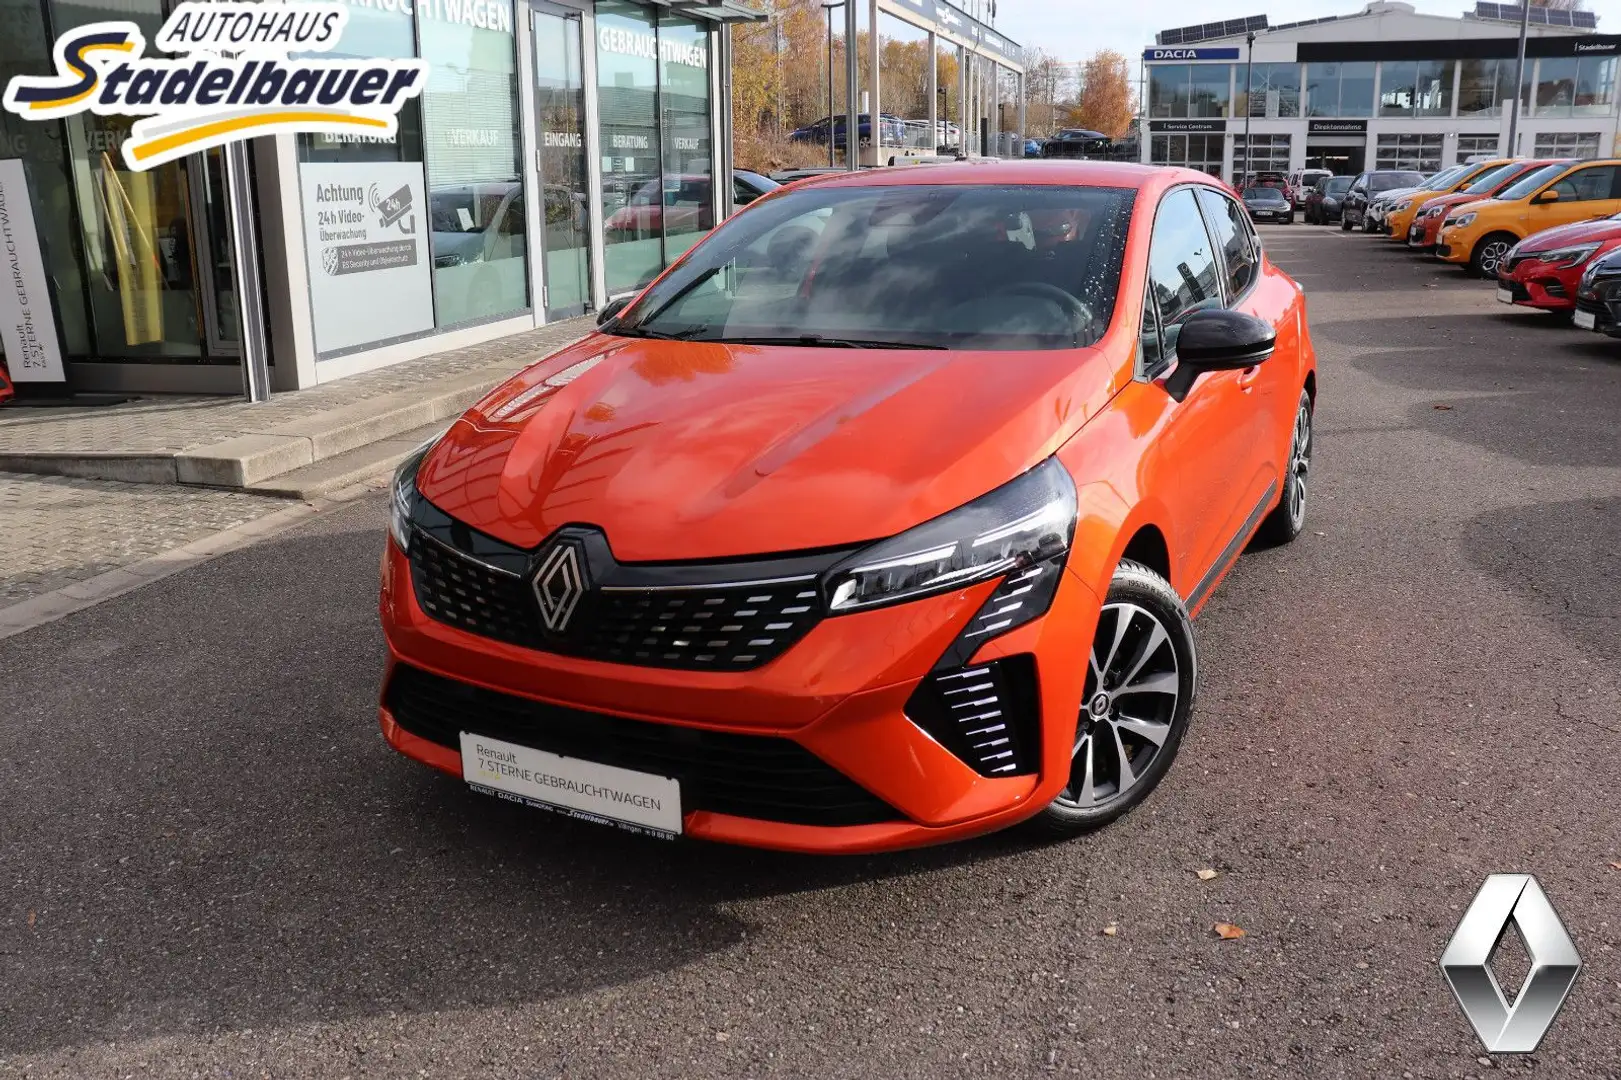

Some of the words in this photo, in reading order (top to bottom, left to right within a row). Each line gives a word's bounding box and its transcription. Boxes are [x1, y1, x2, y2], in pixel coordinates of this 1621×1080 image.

[600, 26, 707, 68] GEBRAUCHTWAGEN
[1154, 49, 1197, 59] DACIA
[450, 128, 499, 146] VERKAUF
[544, 132, 582, 148] EINGANG
[613, 134, 649, 149] BERATUNG
[674, 137, 700, 150] VERKAUF
[316, 183, 364, 205] Achtung
[338, 208, 365, 225] Video-
[0, 182, 29, 306] GEBRAUCHTWAG
[320, 228, 367, 241] Überwachung
[23, 309, 40, 358] STERNE
[16, 324, 31, 368] Renault
[476, 743, 518, 765] Renault
[469, 784, 495, 797] RENAULT
[498, 792, 523, 804] DACIA
[478, 757, 485, 769] 7
[487, 760, 532, 782] STERNE
[534, 772, 661, 811] GEBRAUCHTWAGEN
